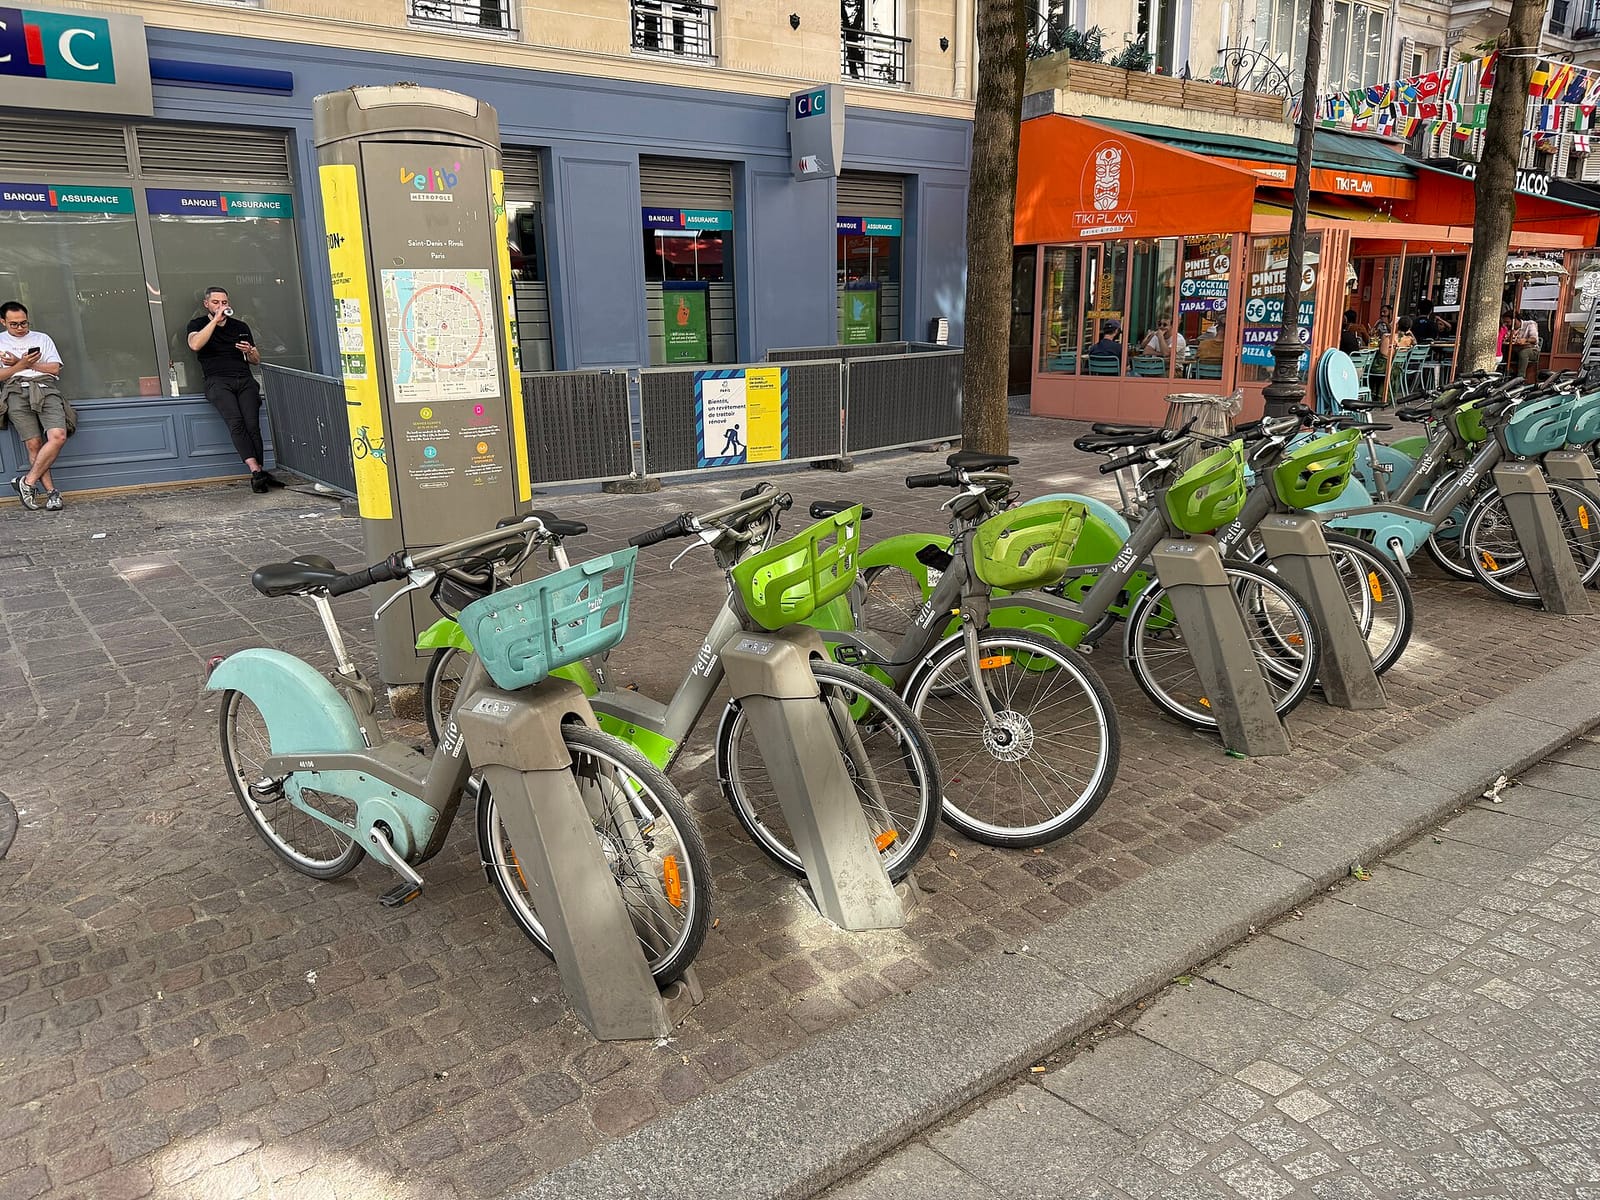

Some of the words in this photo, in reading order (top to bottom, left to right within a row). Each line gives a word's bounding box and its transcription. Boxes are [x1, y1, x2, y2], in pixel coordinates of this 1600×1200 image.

[798, 95, 823, 114] CIC
[1335, 177, 1350, 190] TIKI
[1350, 179, 1373, 193] PLAYA
[1515, 171, 1549, 195] TACOS
[4, 192, 46, 202] BANQUE
[61, 194, 119, 204] ASSURANCE
[181, 198, 217, 207] BANQUE
[231, 200, 281, 209] ASSURANCE
[648, 215, 674, 223] BANQUE
[687, 216, 719, 224] ASSURANCE
[1075, 213, 1094, 224] TIKI
[1097, 213, 1133, 224] PLAYA
[1185, 259, 1210, 271] PINTE
[1214, 257, 1228, 270] 4€
[1252, 270, 1286, 286] PINTE
[1182, 282, 1194, 294] 5€
[1196, 281, 1229, 290] COCKTAIL
[1251, 287, 1262, 296] DE
[1198, 289, 1227, 297] SANGRIA
[1214, 300, 1225, 310] 6€
[1247, 304, 1263, 318] 5€
[1245, 331, 1279, 343] TAPAS
[1242, 347, 1265, 357] PIZZA
